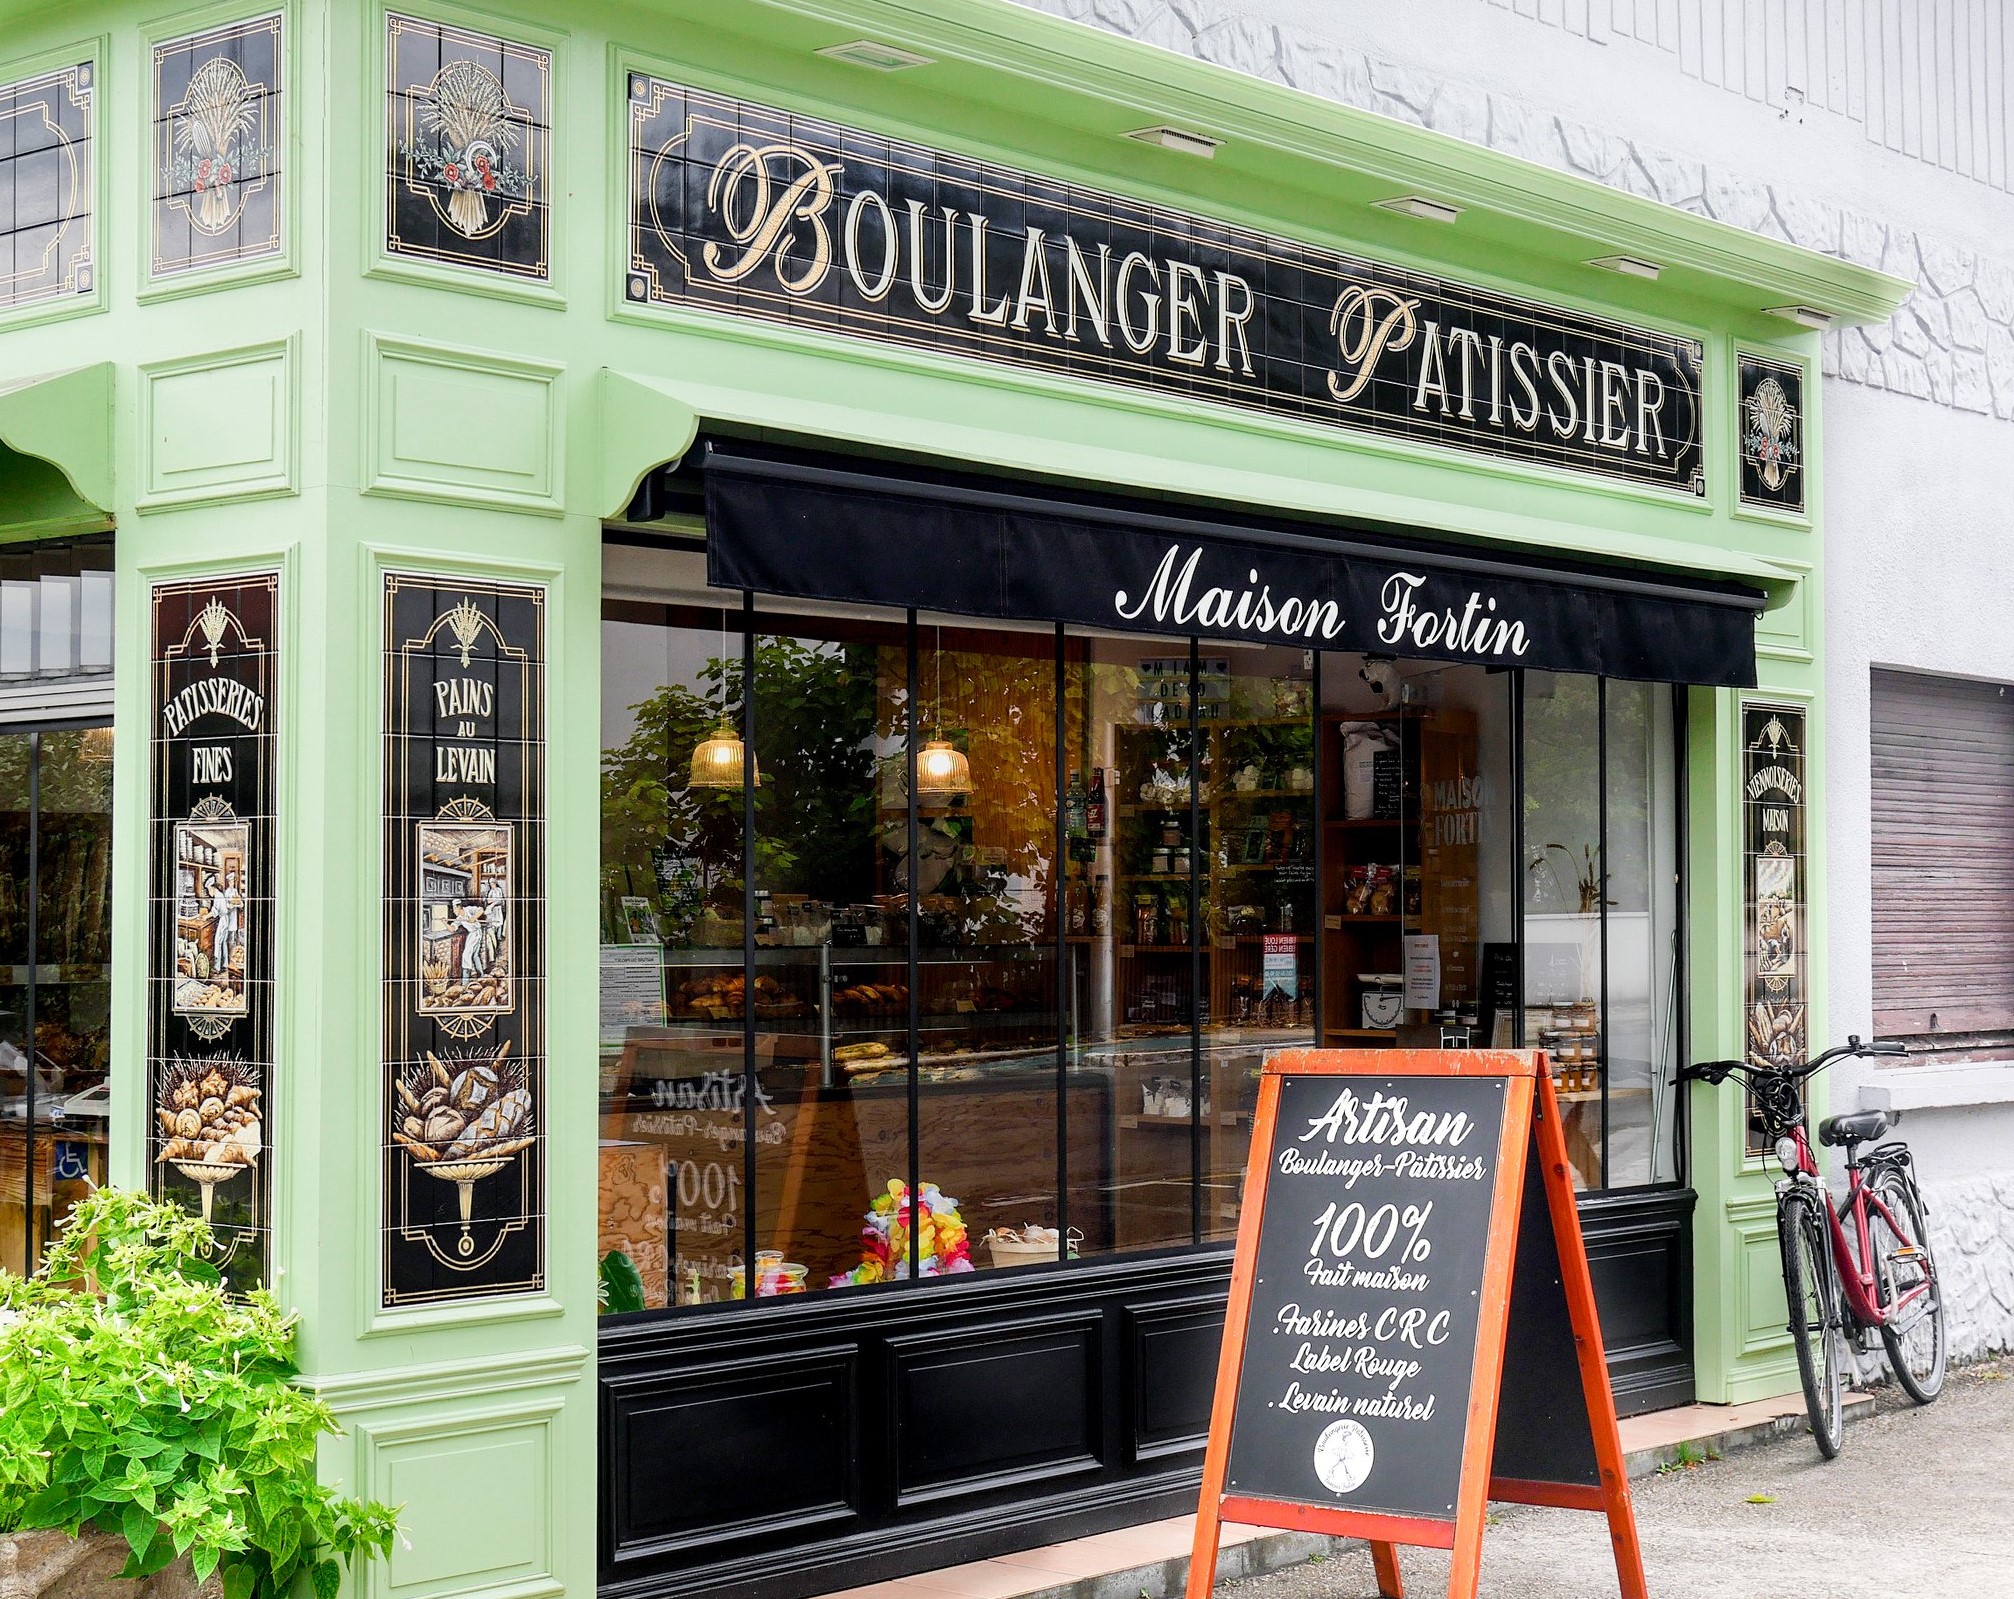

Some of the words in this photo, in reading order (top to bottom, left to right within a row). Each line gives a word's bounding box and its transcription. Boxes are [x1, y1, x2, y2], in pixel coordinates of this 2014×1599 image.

[702, 143, 1256, 378] BOULANGER
[1326, 283, 1669, 459] PATISSIER
[1114, 544, 1346, 639] Maison
[1377, 571, 1531, 656] Fortin
[163, 676, 264, 738] PATISSERIES
[432, 678, 494, 718] PAINS
[456, 720, 476, 738] AU
[191, 746, 233, 784] FINES
[435, 746, 496, 785] LEVAIN
[1746, 765, 1802, 804] VIENNOISERIES
[1762, 808, 1789, 833] MAISON
[1298, 1087, 1475, 1147] Artisan
[1309, 1200, 1434, 1265] 100%
[1303, 1257, 1356, 1287] Fait
[1351, 1265, 1431, 1292] maison
[1289, 1341, 1353, 1374] Label
[1353, 1345, 1423, 1391] Rouge
[1352, 1390, 1436, 1421] naturel
